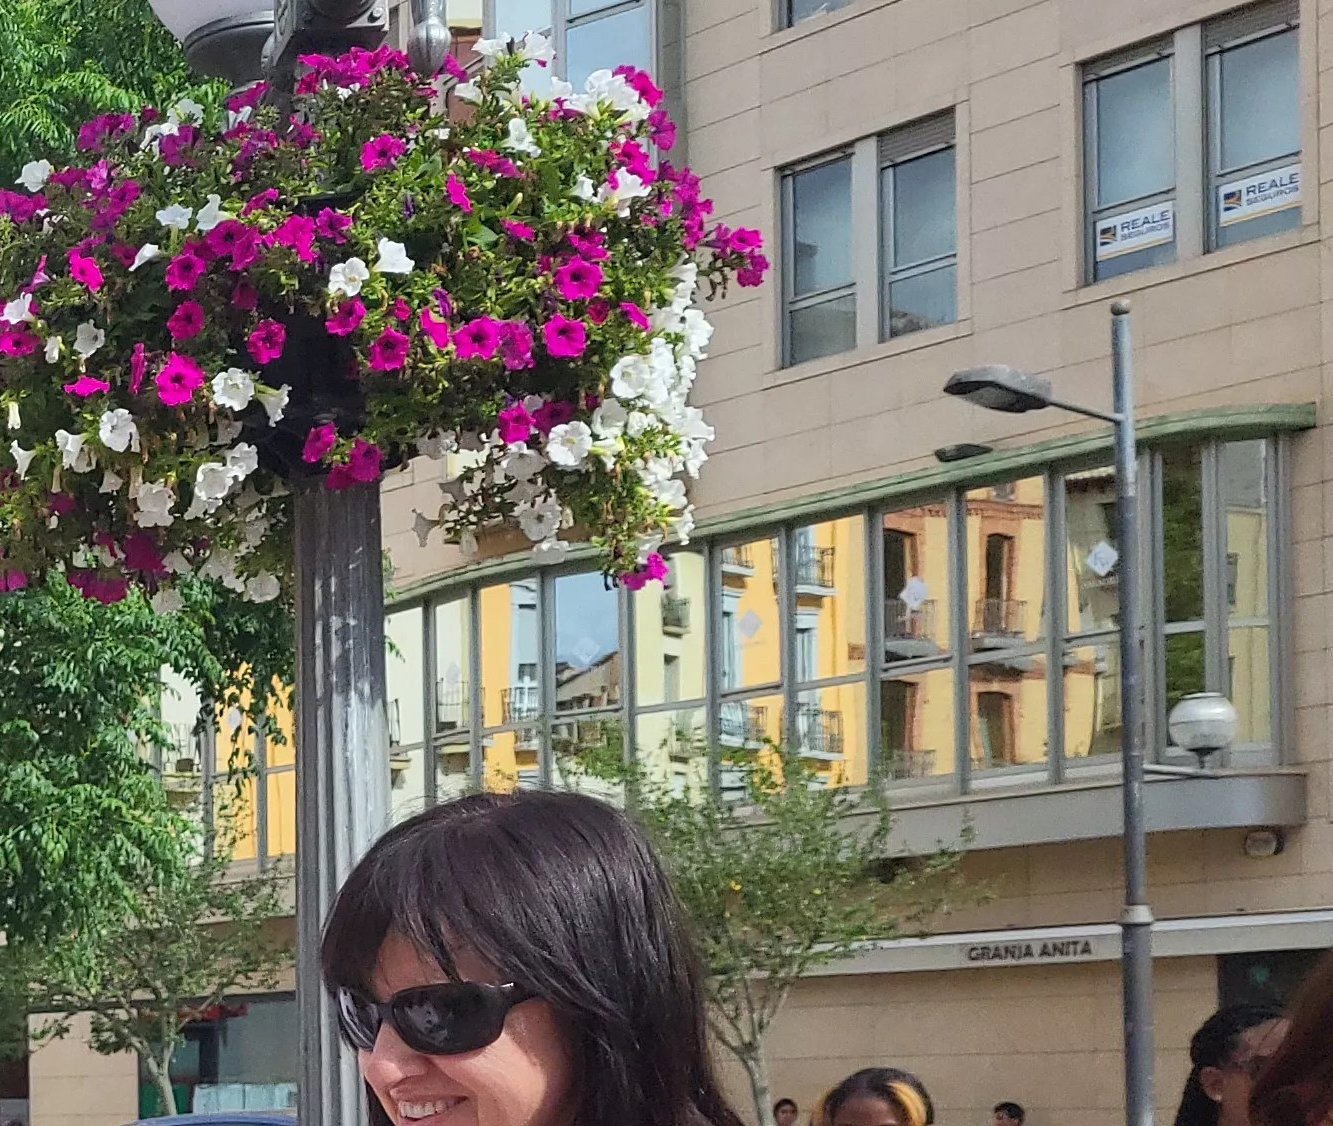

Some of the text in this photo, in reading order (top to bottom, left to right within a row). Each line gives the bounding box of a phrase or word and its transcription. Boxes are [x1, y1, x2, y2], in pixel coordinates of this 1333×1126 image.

[1246, 173, 1299, 195] REALE
[1246, 185, 1299, 206] SEGUROS
[1120, 210, 1171, 232] REALE
[968, 940, 1092, 960] GRANJA ANITA
